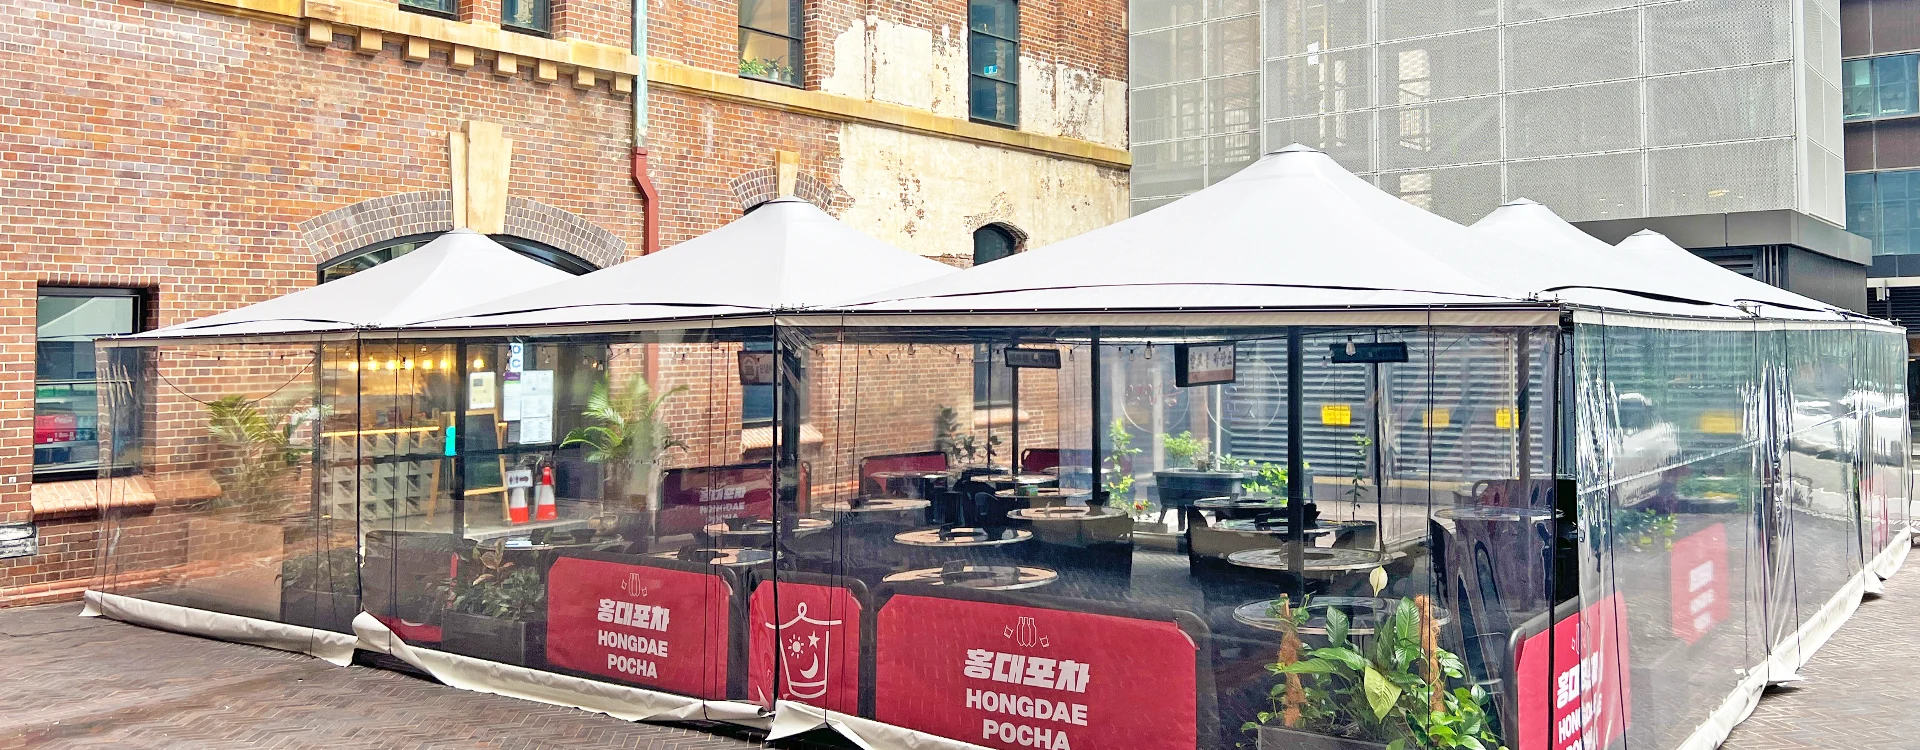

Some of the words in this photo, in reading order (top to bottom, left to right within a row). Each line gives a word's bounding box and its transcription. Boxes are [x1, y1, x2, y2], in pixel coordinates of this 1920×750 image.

[597, 598, 670, 633] 홍대포차
[598, 629, 669, 658] HONGDAE
[607, 653, 658, 679] POCHA
[963, 648, 1090, 693] 홍대포차
[965, 688, 1088, 727] HONGDAE
[982, 718, 1071, 750] POCHA
